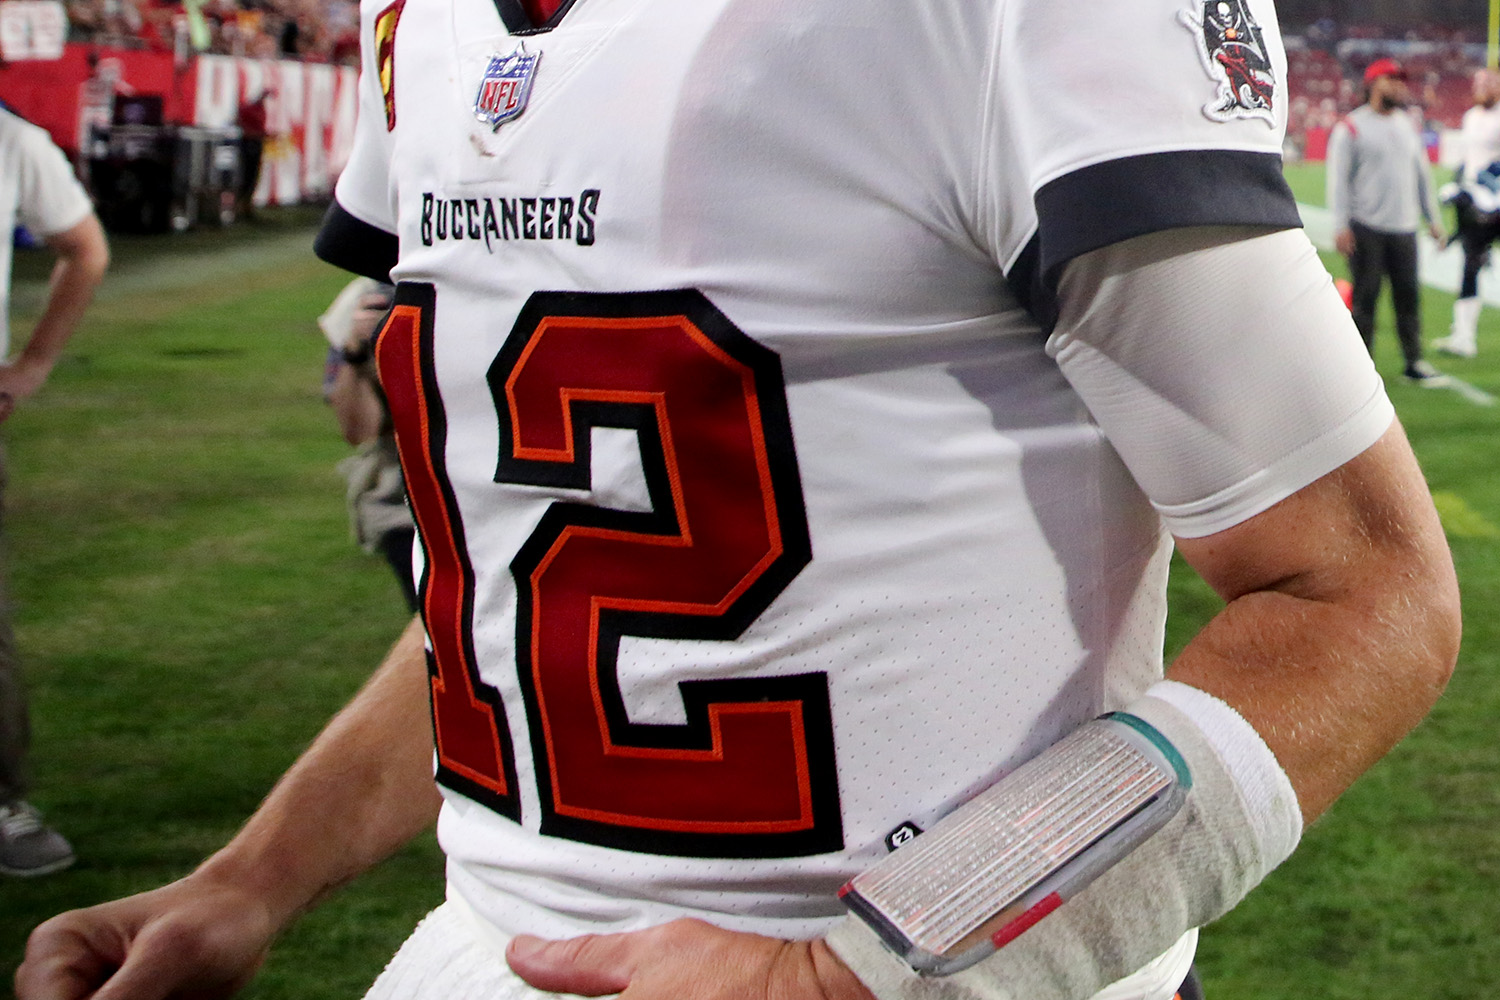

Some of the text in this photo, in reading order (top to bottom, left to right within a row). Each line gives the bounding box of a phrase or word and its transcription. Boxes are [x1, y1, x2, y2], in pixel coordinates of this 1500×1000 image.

[480, 81, 518, 113] NFL
[421, 189, 601, 254] BUCCANEERS
[375, 281, 845, 858] 12
